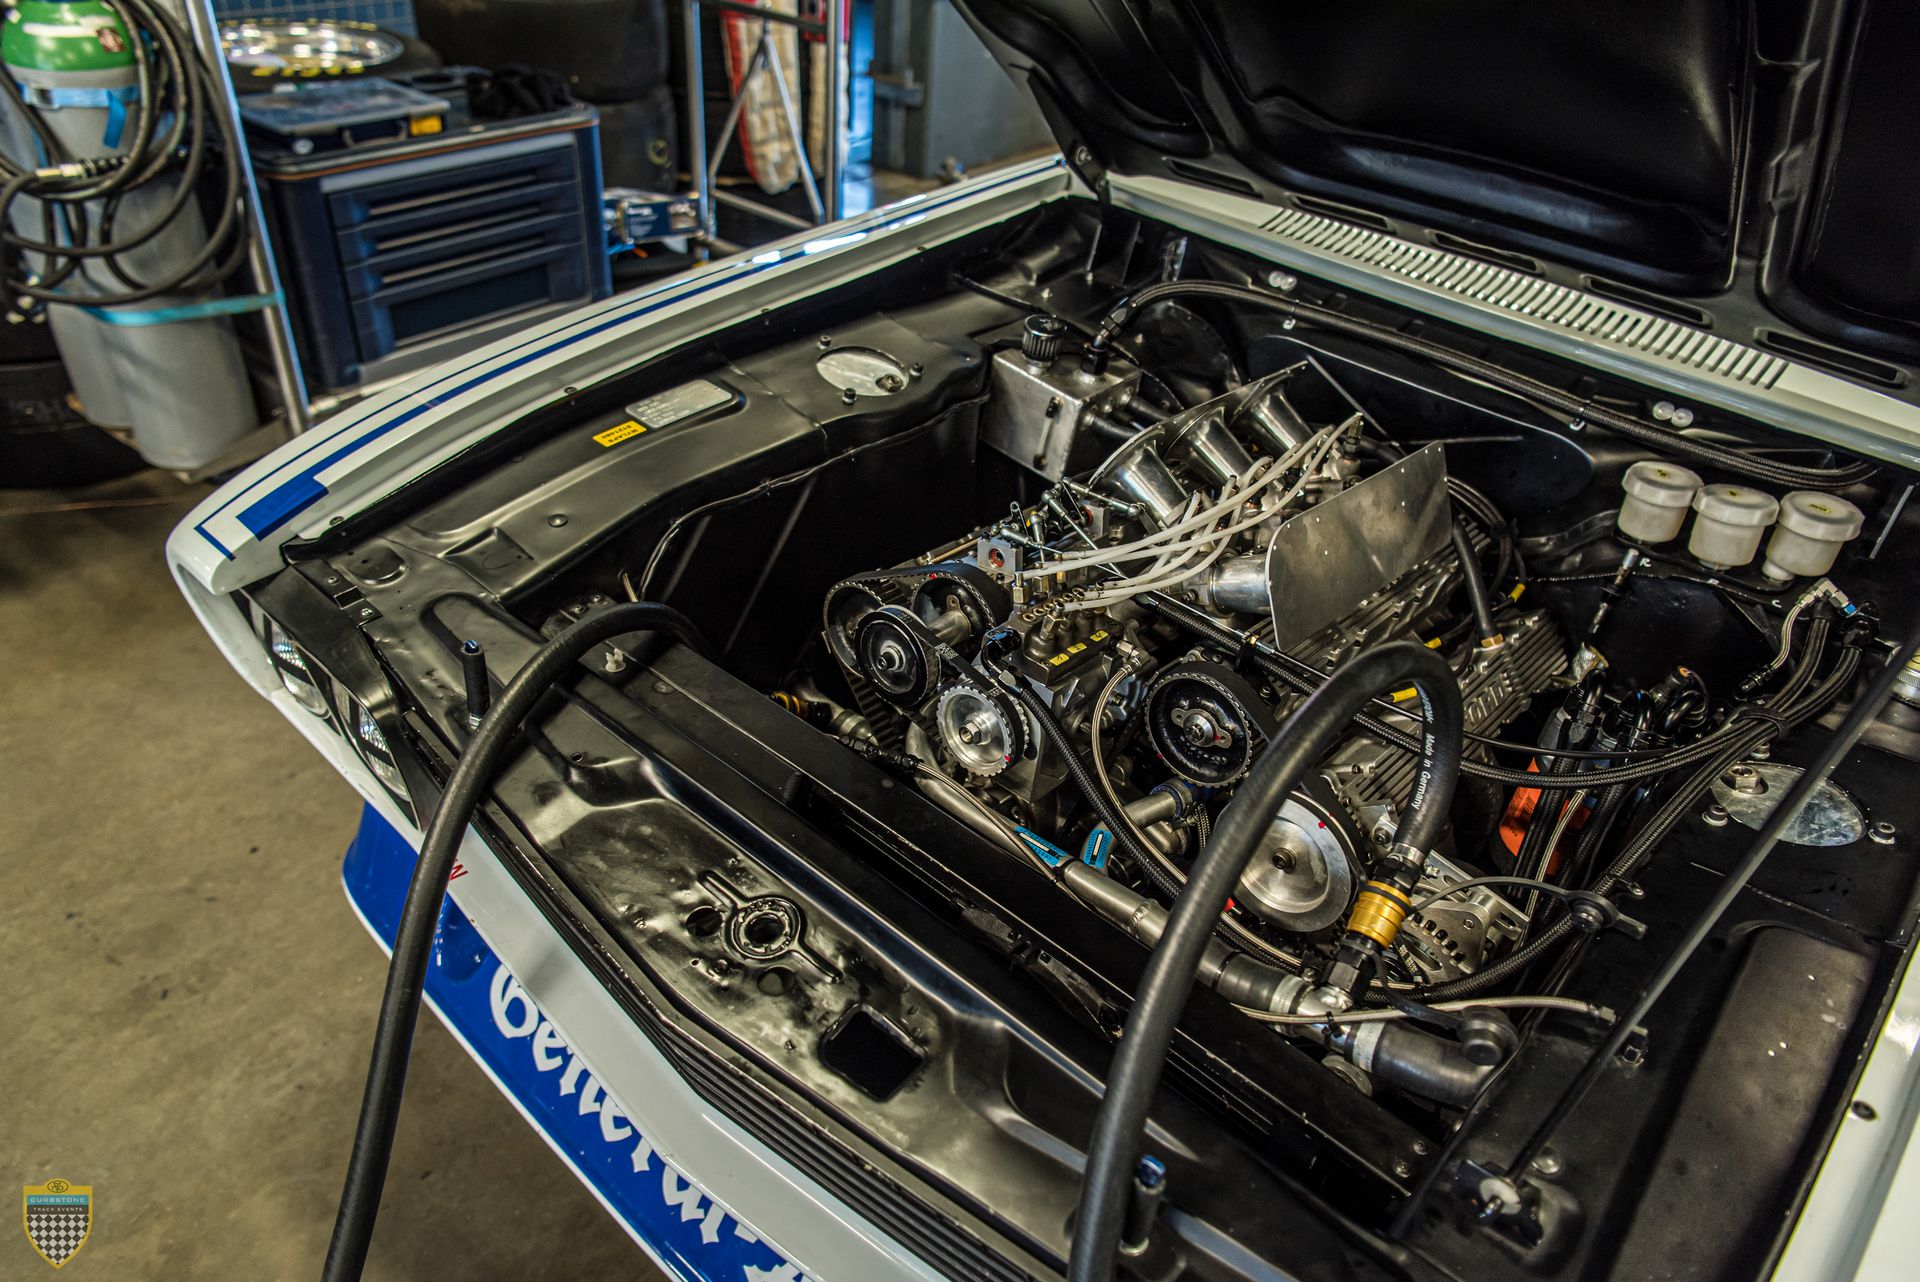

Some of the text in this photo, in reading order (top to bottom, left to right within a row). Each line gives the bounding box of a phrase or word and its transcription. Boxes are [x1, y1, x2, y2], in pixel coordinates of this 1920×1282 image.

[1463, 685, 1504, 729] ORD
[1425, 733, 1435, 756] Made
[1423, 758, 1434, 768] in
[1411, 771, 1431, 810] Germany
